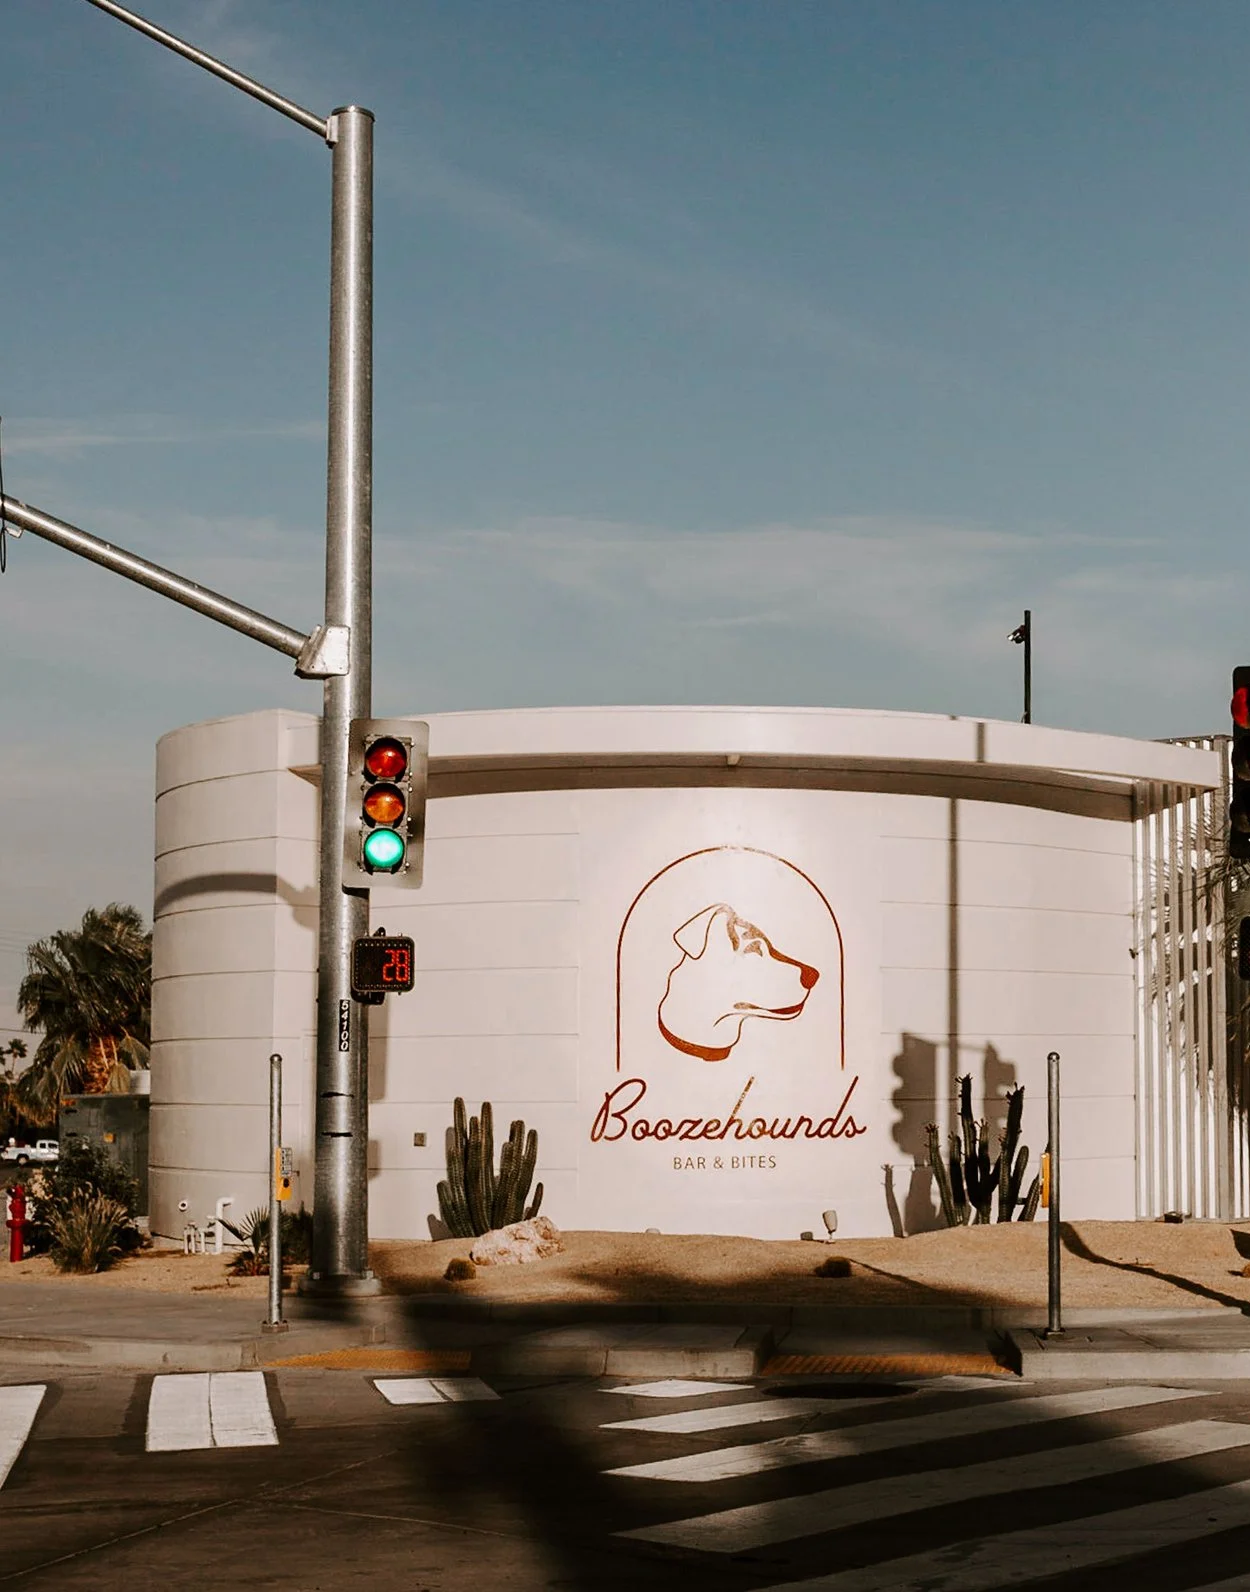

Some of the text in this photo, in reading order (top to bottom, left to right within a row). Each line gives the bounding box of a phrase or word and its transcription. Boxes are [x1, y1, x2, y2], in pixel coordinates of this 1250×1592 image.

[383, 949, 409, 982] 28
[340, 1000, 349, 1051] 54100
[590, 1075, 868, 1143] Boozehounds
[673, 1154, 777, 1170] BAR & BITES
